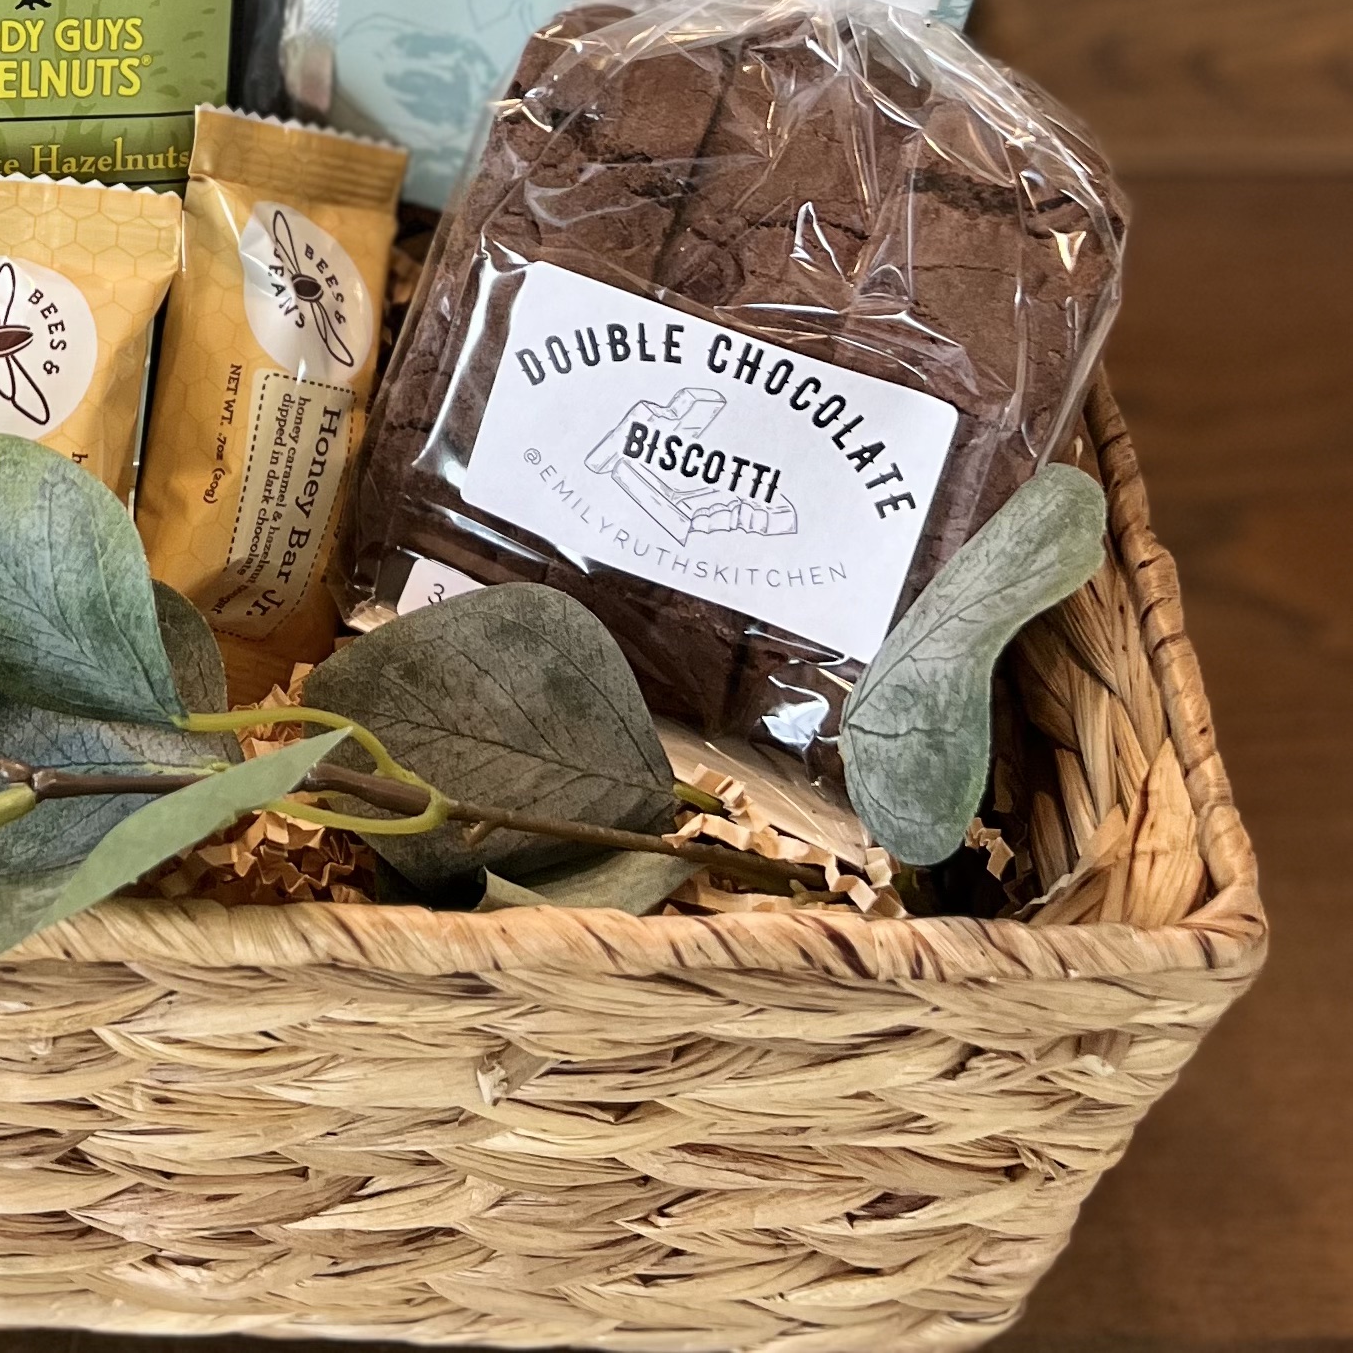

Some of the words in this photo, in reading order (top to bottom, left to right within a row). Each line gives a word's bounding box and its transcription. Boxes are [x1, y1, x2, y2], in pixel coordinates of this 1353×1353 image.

[54, 17, 144, 53] GUYS
[32, 137, 190, 175] Hazelnuts
[304, 243, 345, 304] BEES
[334, 310, 346, 325] &
[28, 289, 68, 351] BEES
[42, 360, 60, 375] &
[226, 364, 242, 396] NET
[219, 398, 237, 426] WT.
[275, 392, 296, 448] dipped
[288, 395, 312, 444] honey
[515, 323, 686, 386] DOUBLE
[707, 333, 918, 520] CHOCOLATE
[269, 451, 285, 466] in
[278, 447, 297, 509] caramel
[295, 405, 342, 519] Honey
[623, 422, 782, 504] BISCOTTI
[202, 466, 227, 505] (20g)
[260, 469, 278, 504] dark
[236, 507, 268, 577] chocolate
[272, 510, 283, 522] &
[522, 447, 848, 588] @EMILYRUTHSKITCHEN
[246, 526, 281, 584] hazelnut
[276, 526, 312, 585] Bar
[245, 589, 286, 617] Jr.
